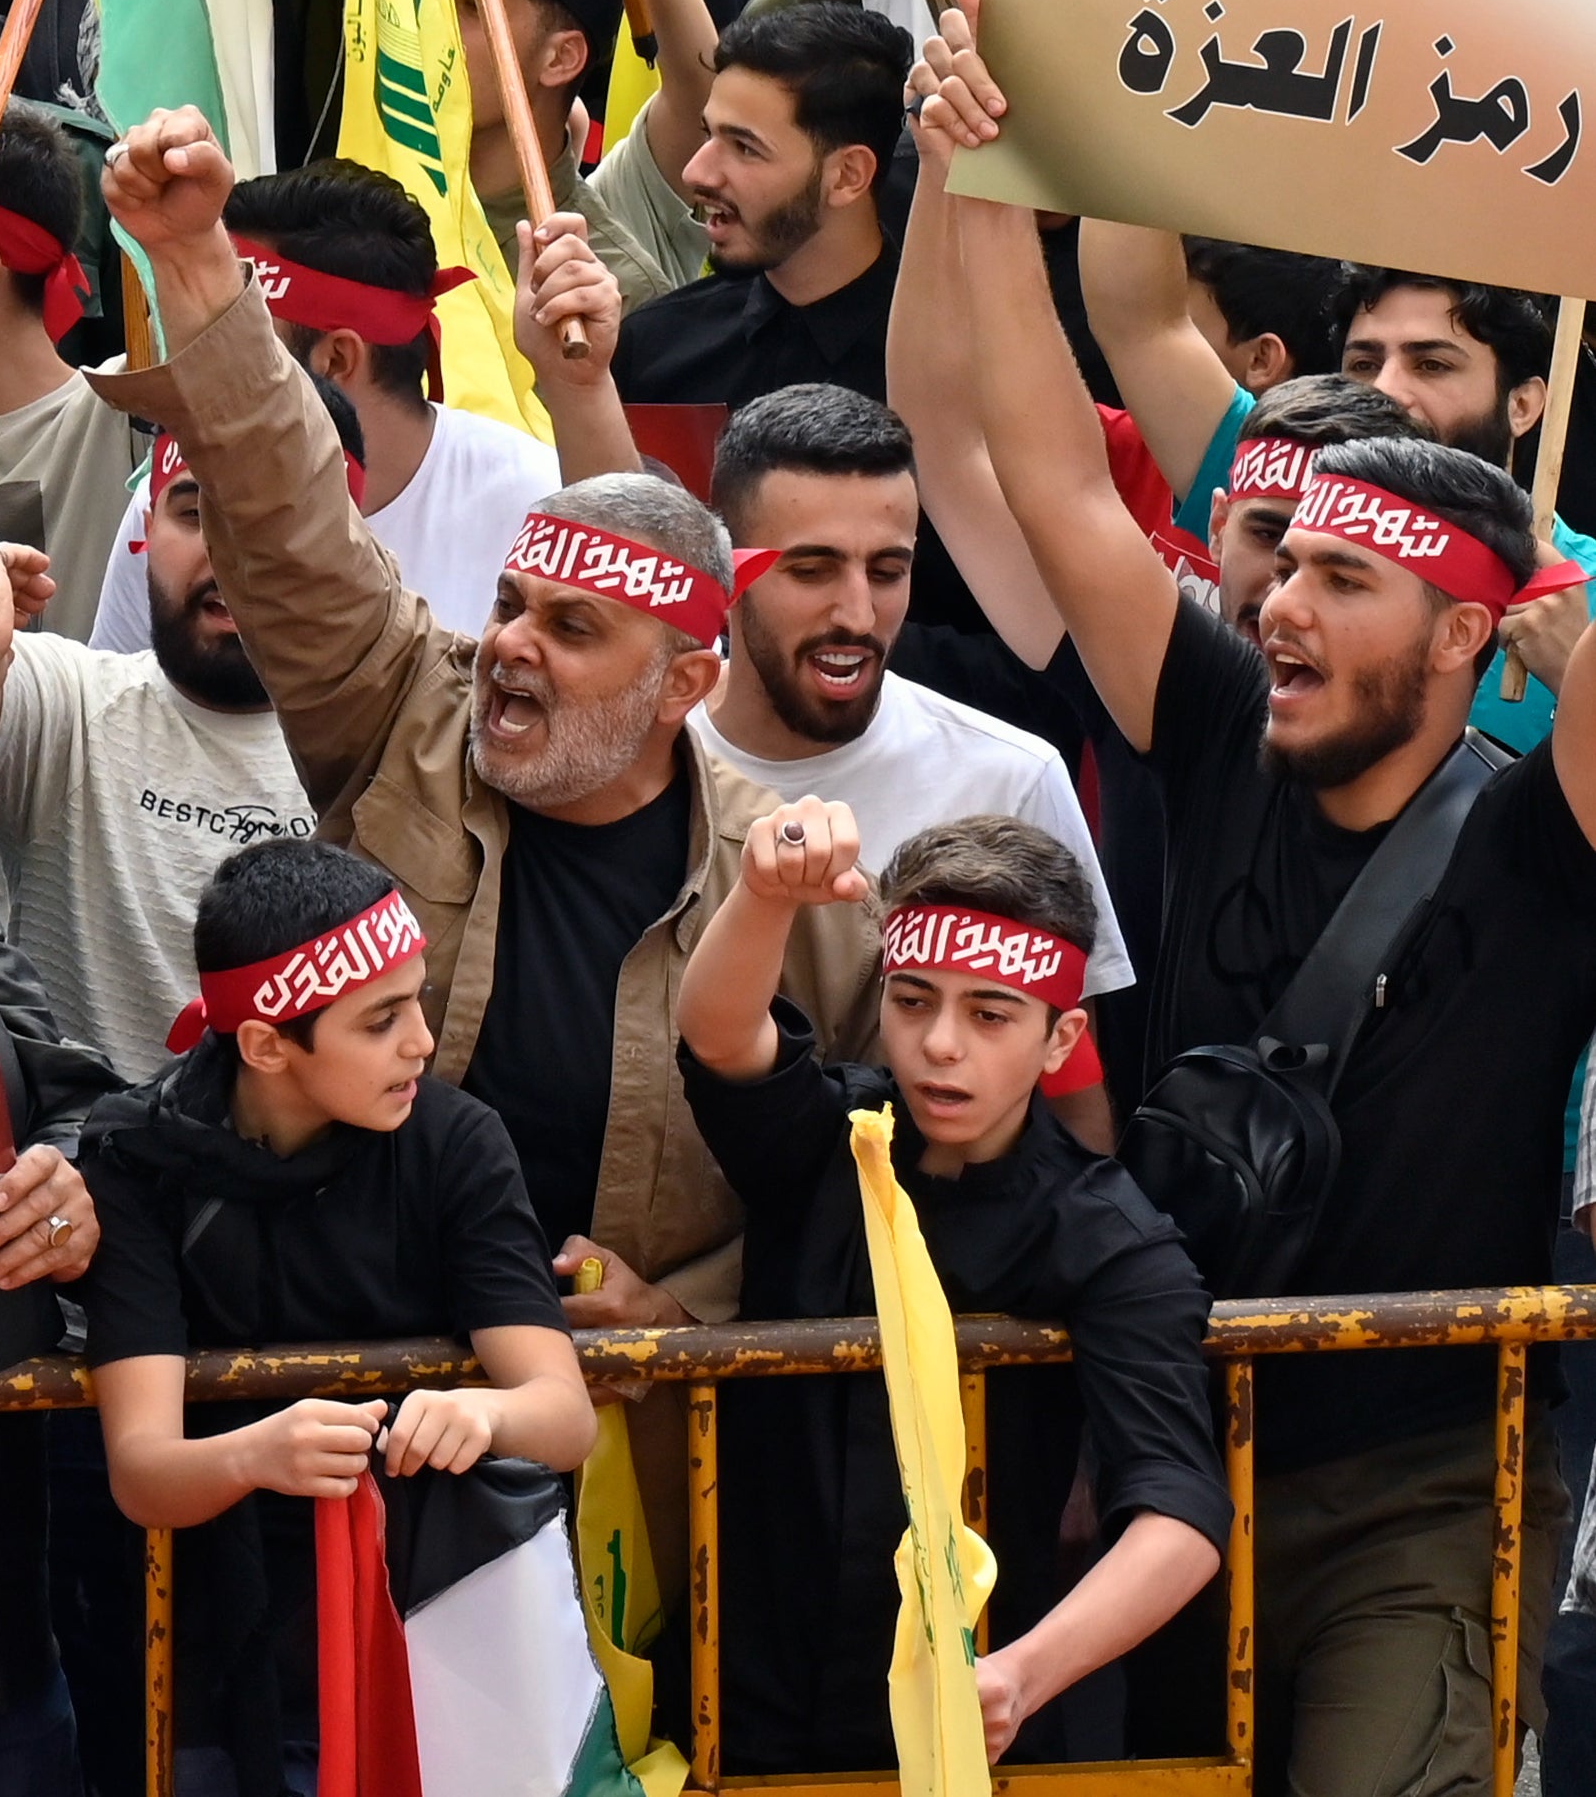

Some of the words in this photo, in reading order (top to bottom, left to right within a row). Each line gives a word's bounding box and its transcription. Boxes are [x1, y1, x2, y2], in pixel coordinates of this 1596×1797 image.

[1393, 34, 1582, 186] رمز
[1330, 484, 1449, 558] شهيد
[578, 535, 693, 607] شهيد
[951, 914, 1063, 984] شهيد
